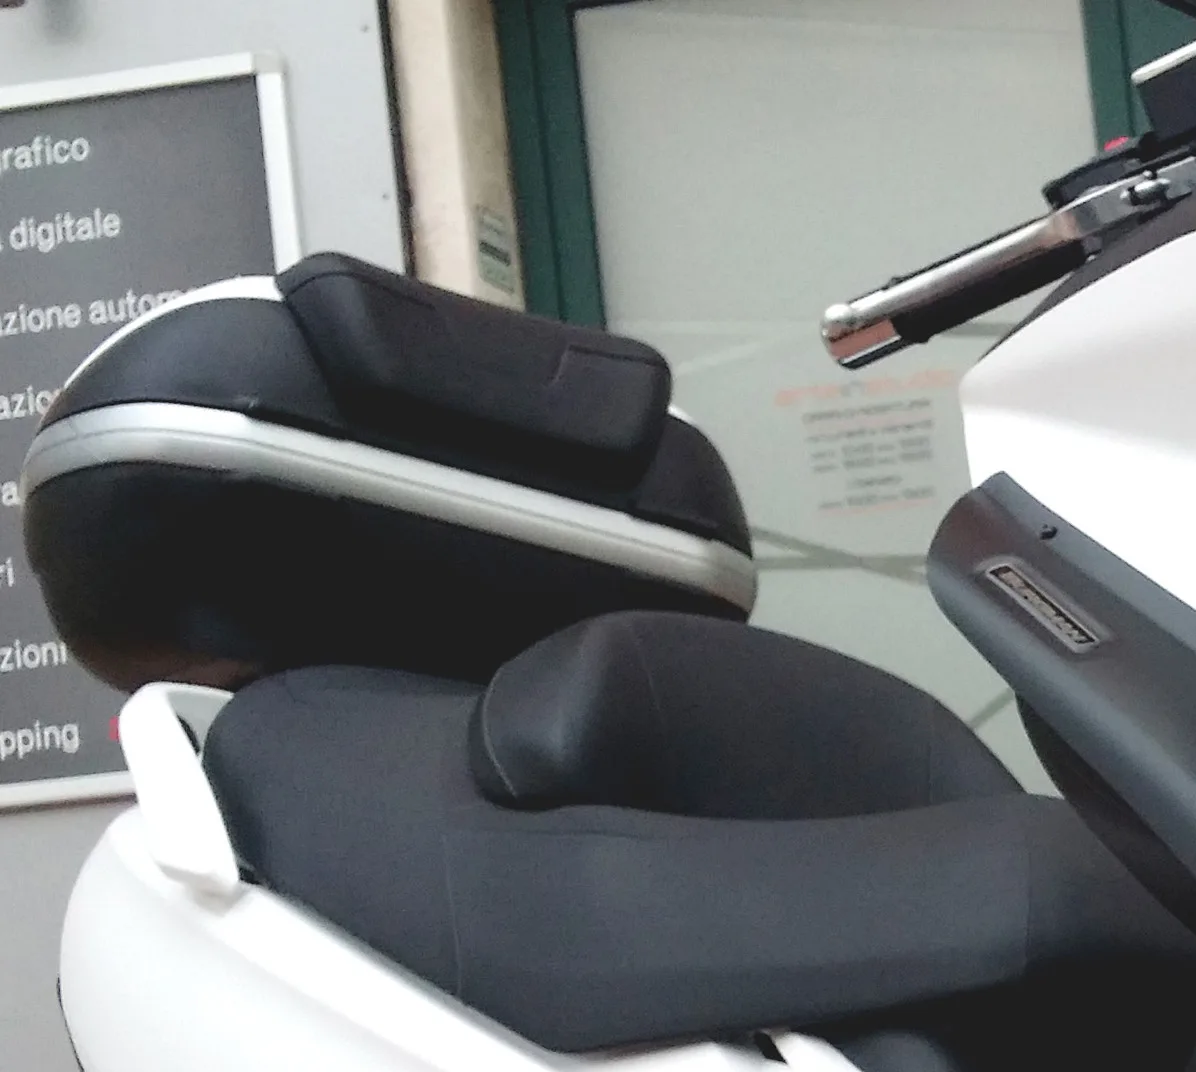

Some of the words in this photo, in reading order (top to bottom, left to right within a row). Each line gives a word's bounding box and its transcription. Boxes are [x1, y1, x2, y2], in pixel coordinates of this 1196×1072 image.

[0, 136, 90, 171] rafico
[9, 208, 121, 253] digitale
[0, 303, 82, 336] zione
